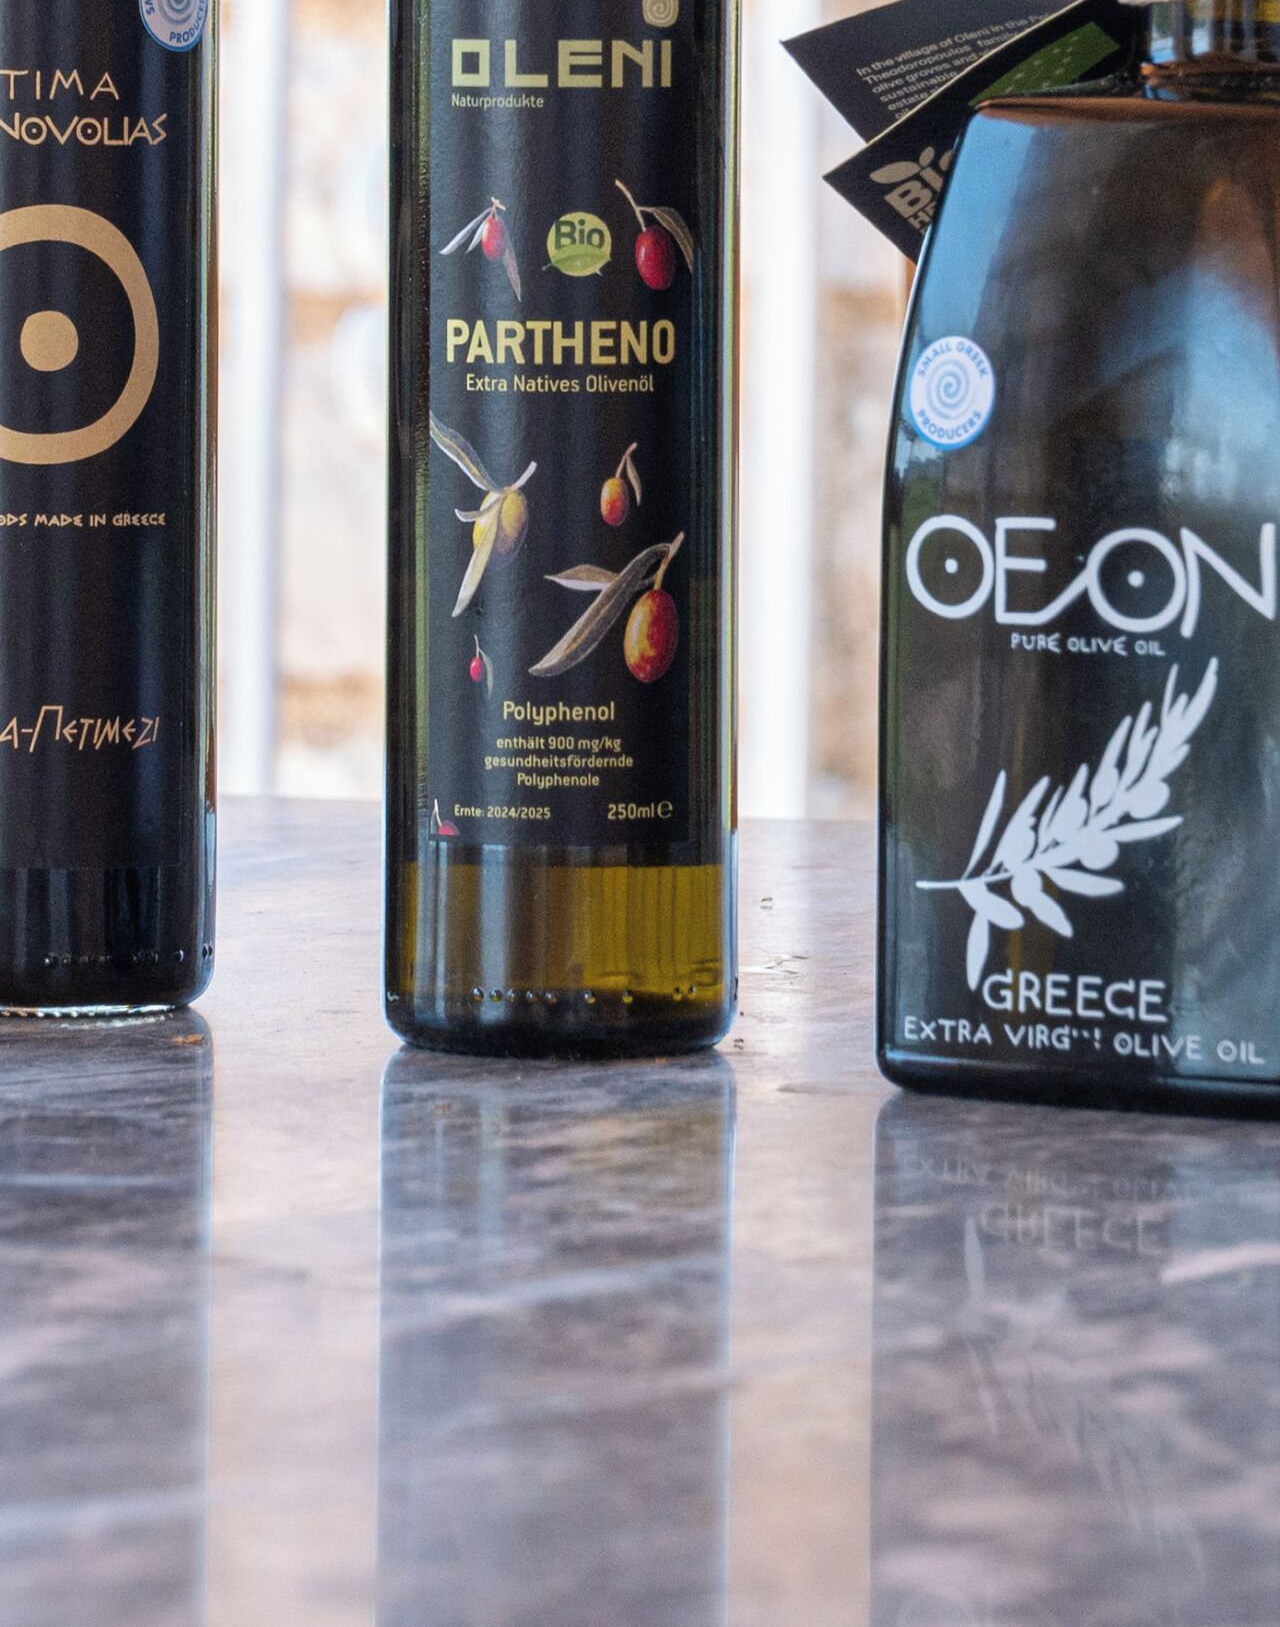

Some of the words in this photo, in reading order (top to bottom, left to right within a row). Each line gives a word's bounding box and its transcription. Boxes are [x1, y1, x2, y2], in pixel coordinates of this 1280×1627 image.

[894, 43, 938, 62] village
[451, 38, 672, 88] OLENI
[451, 93, 544, 110] Naturprodukte
[554, 219, 605, 250] Bio
[446, 319, 675, 365] PARTHENO
[466, 373, 507, 392] Extra
[513, 375, 579, 392] Natives
[586, 374, 654, 392] Olivenöl
[34, 514, 83, 527] MADE
[90, 514, 106, 527] IN
[112, 512, 166, 526] GREECE
[1011, 632, 1061, 653] PURE
[1068, 635, 1127, 655] OLIVE
[1135, 639, 1166, 656] OIL
[503, 701, 615, 725] Polyphenol
[496, 736, 545, 749] enthält
[548, 736, 574, 749] 900
[578, 736, 622, 753] mg/kg
[484, 754, 633, 769] gesundheitsfördernde
[517, 773, 600, 789] Polyphenole
[454, 804, 485, 817] Ernte:
[487, 806, 551, 818] 2024/2025
[982, 968, 1168, 1023] GREECE
[904, 1016, 992, 1046] EXTRA
[1004, 1023, 1101, 1050] VIRG
[1114, 1031, 1202, 1061] OLIVE
[1217, 1040, 1266, 1064] OIL
